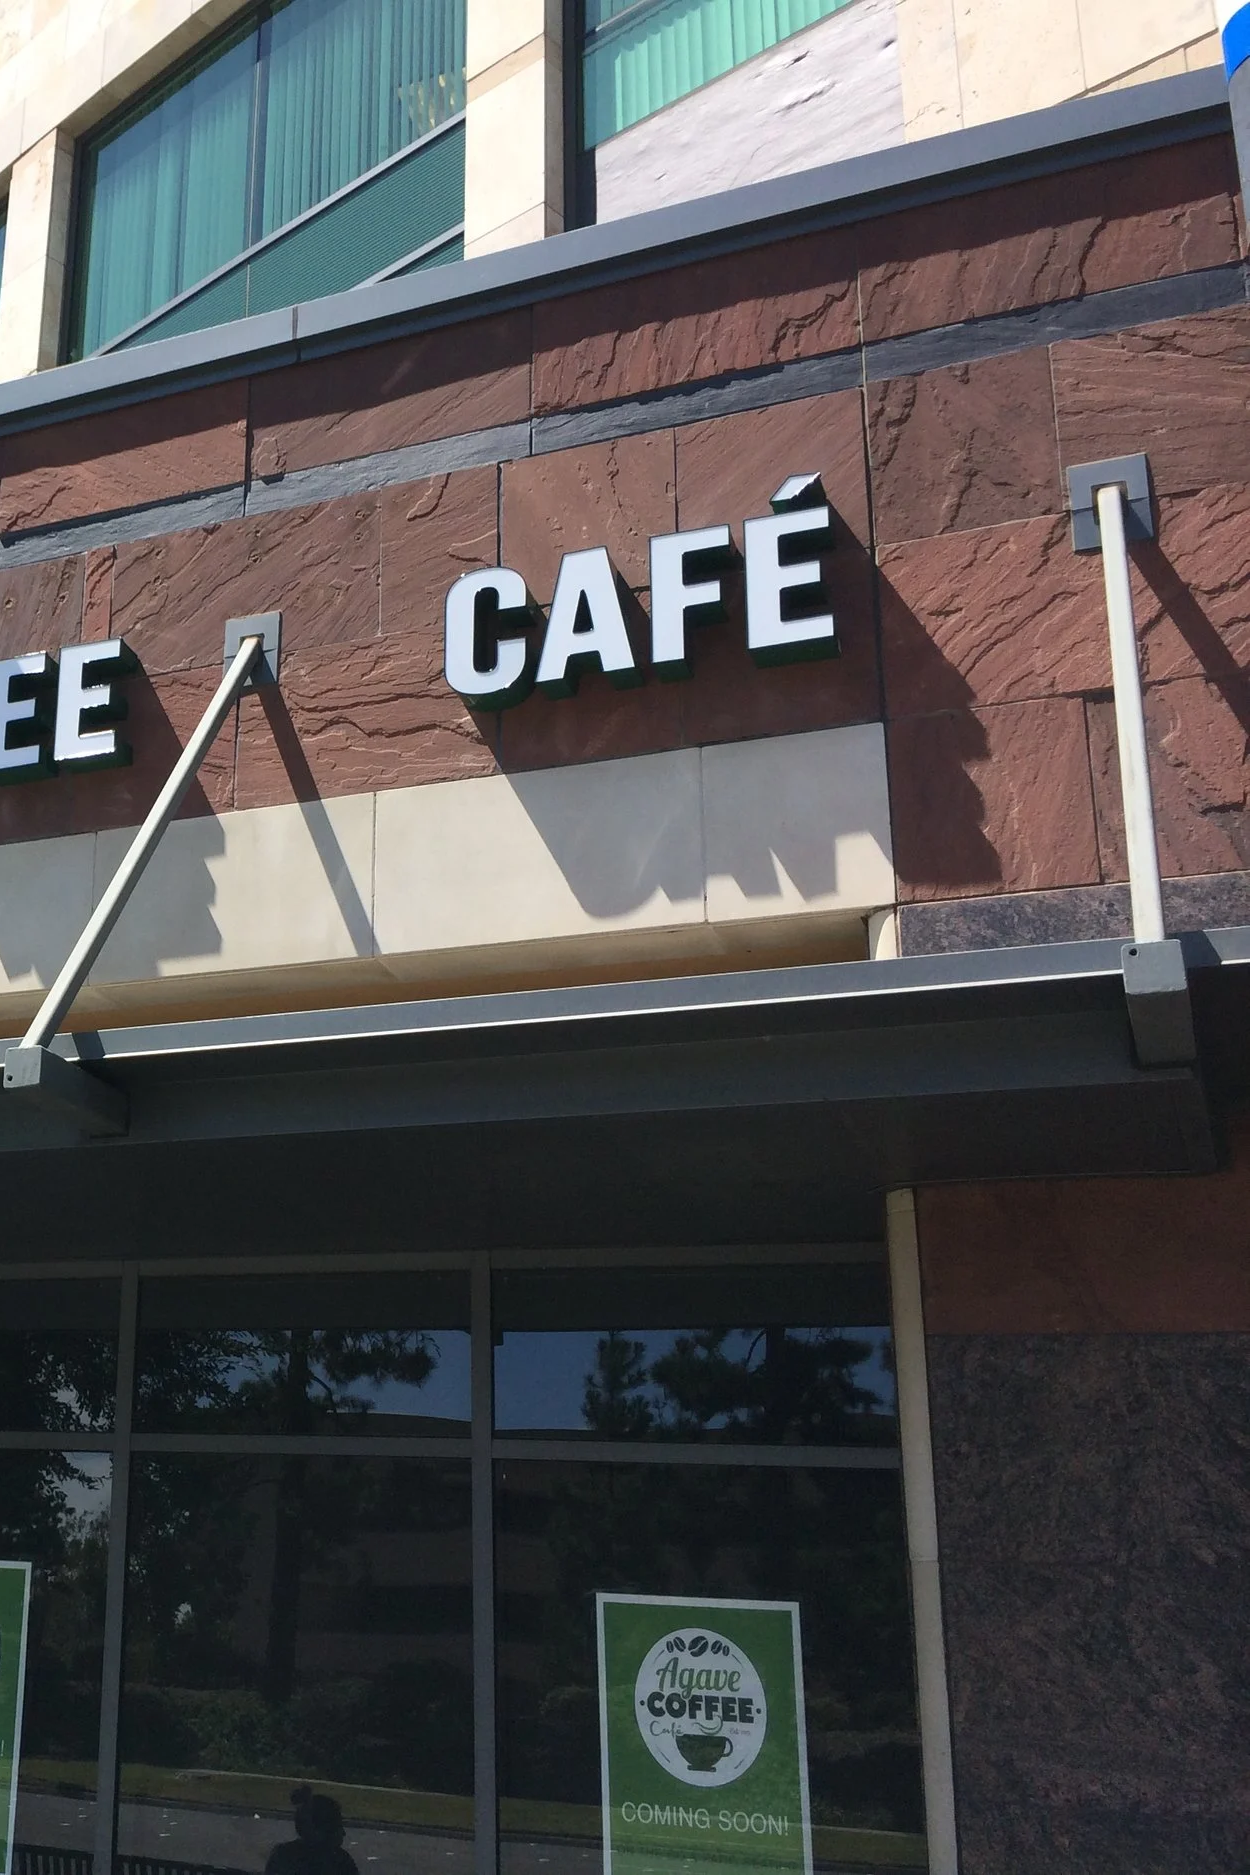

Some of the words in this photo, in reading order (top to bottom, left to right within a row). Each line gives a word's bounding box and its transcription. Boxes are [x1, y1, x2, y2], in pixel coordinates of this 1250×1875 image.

[444, 472, 836, 695] CAFÉ
[656, 1656, 741, 1699] Agave
[646, 1691, 755, 1724] COFFEE
[650, 1720, 685, 1738] Café
[621, 1801, 711, 1830] COMING
[718, 1810, 789, 1837] SOON!
